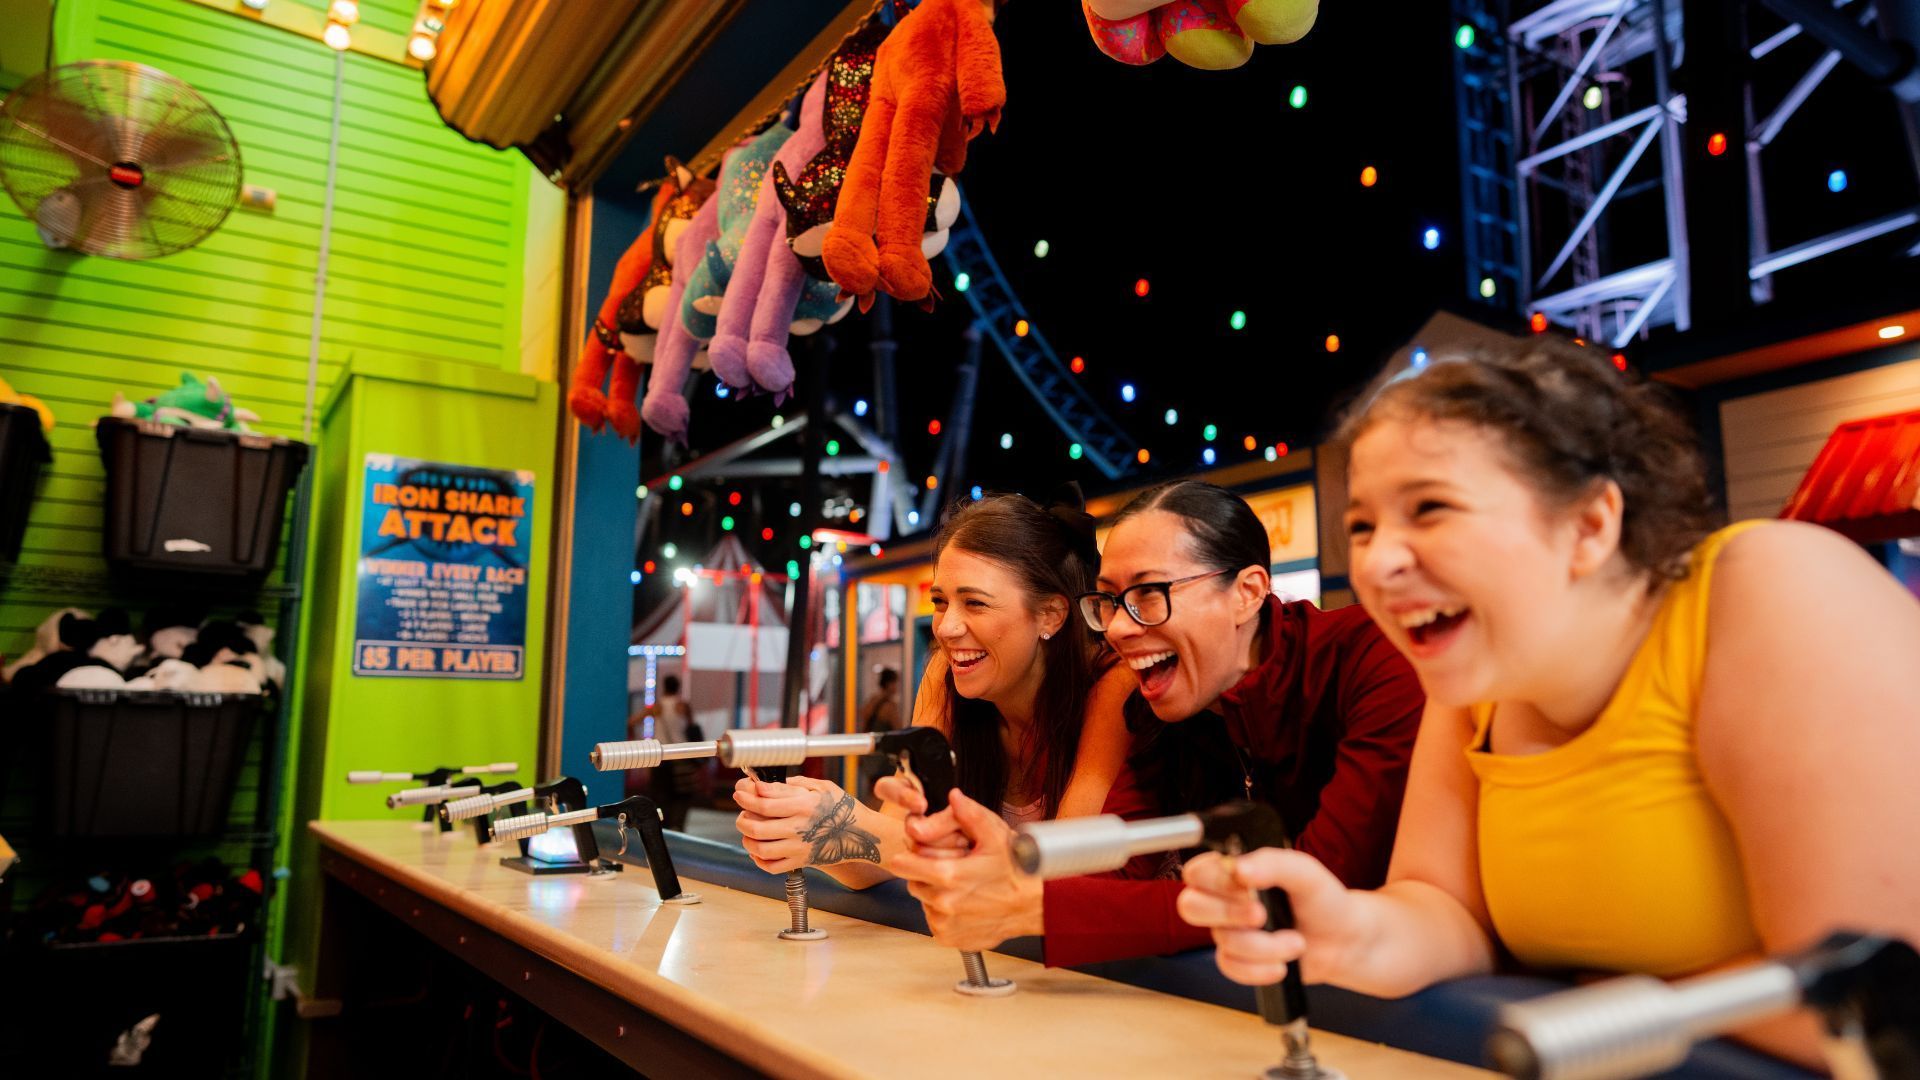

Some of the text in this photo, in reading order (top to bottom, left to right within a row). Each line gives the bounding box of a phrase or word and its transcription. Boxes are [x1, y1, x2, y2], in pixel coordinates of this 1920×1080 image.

[373, 483, 525, 517] IRON SHARK
[378, 508, 518, 547] ATTACK
[366, 557, 525, 586] WINNER EVERY RACE
[363, 646, 516, 673] $5 PER PLAYER
